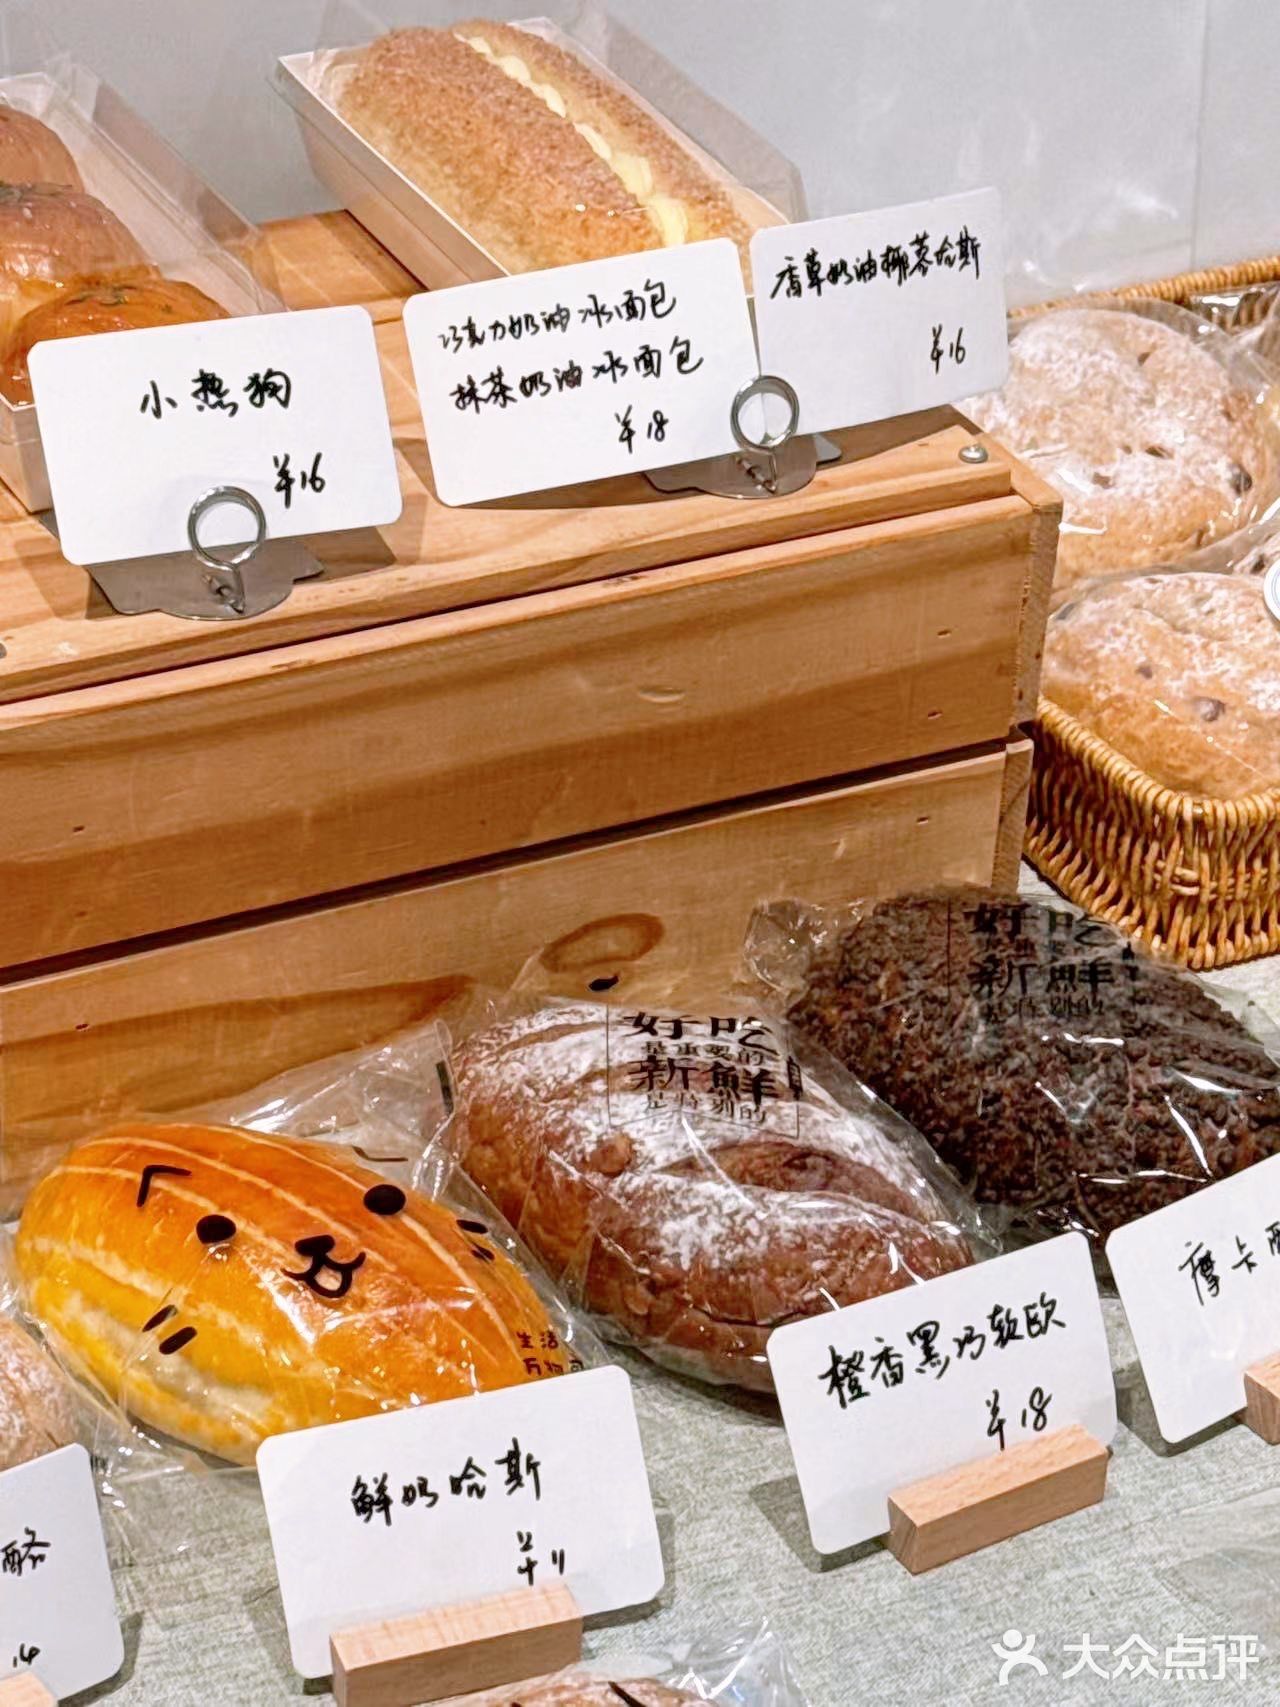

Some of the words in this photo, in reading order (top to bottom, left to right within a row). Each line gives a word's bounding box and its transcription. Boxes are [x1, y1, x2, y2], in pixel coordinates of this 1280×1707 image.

[141, 369, 291, 418] 小热狗
[624, 1011, 779, 1056] 好吃
[516, 1330, 558, 1349] 生活
[351, 1438, 540, 1526] 鲜奶哈斯
